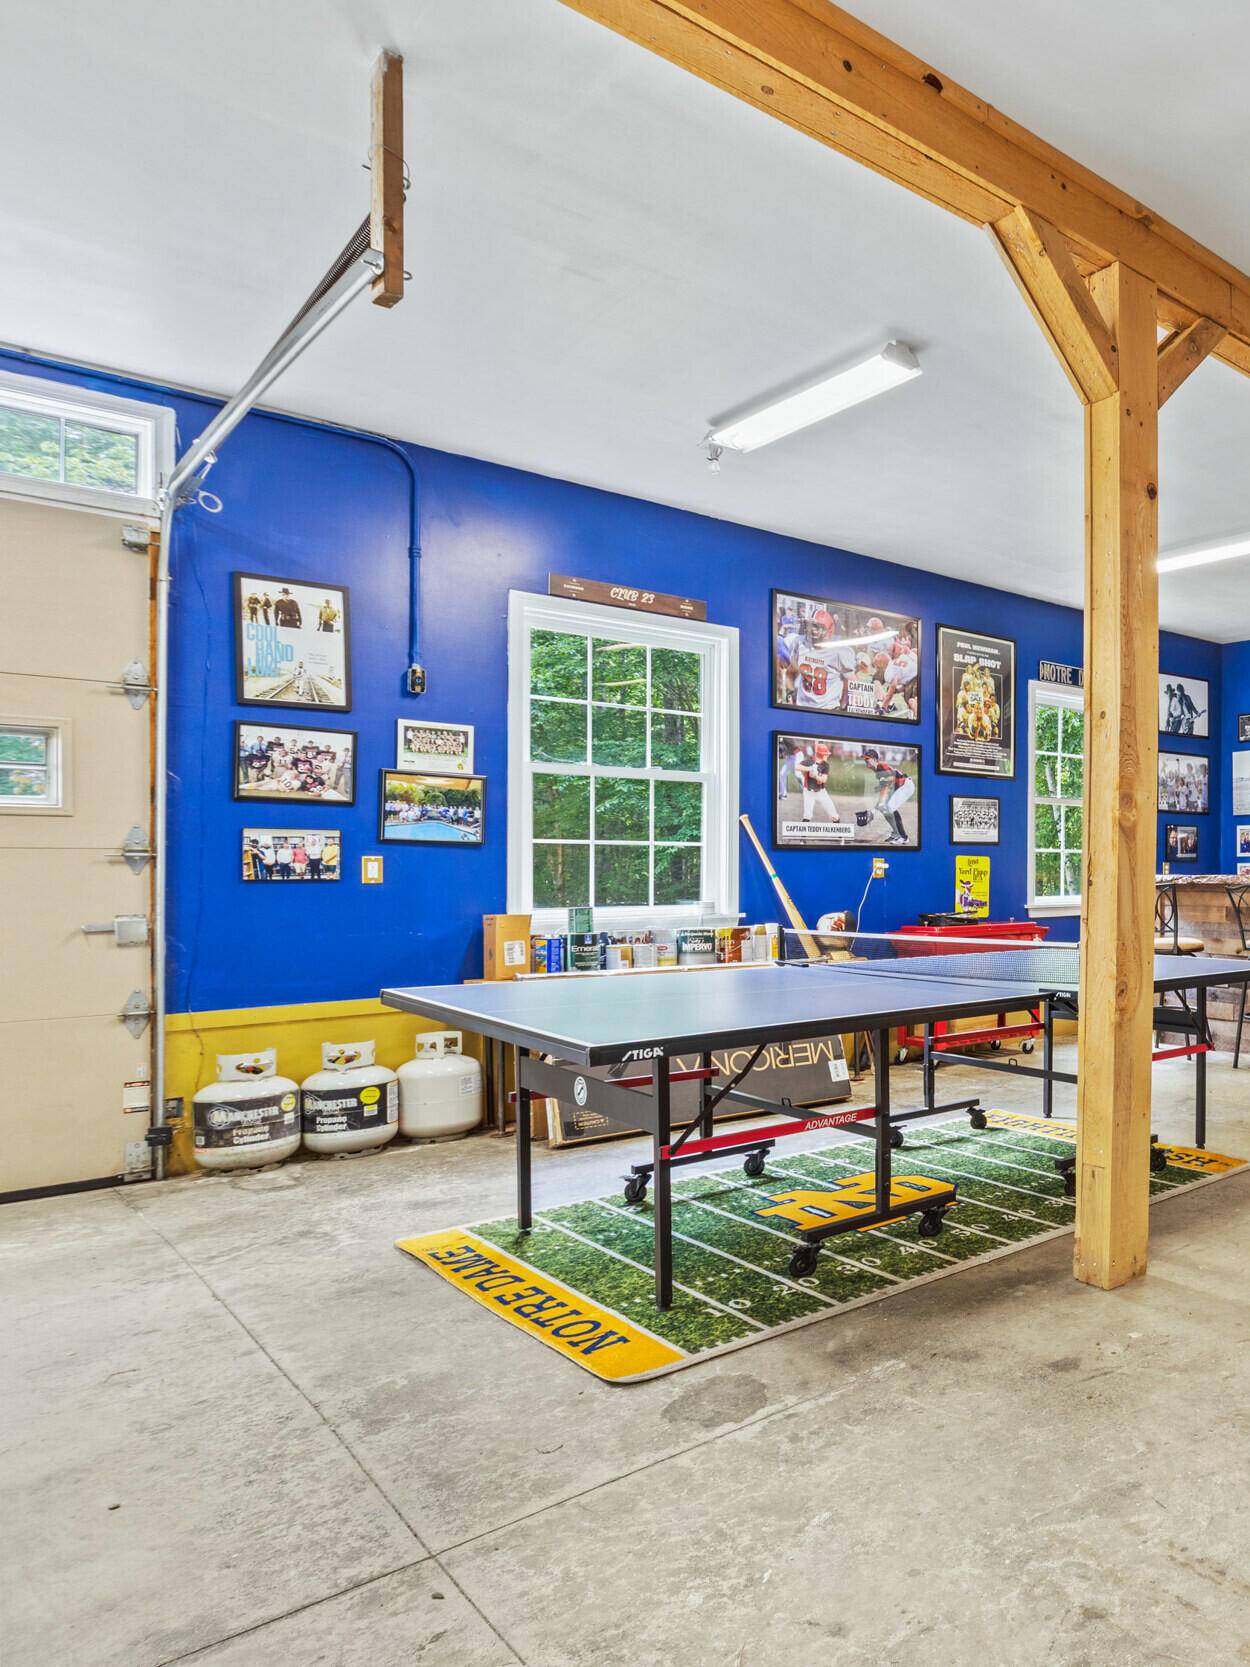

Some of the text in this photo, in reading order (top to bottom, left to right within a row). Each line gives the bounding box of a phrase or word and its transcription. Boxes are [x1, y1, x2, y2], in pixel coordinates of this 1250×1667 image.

[610, 587, 656, 605] CLUB 23
[247, 622, 277, 641] COOL
[256, 639, 294, 662] HAND
[953, 653, 977, 664] SLAP
[978, 657, 1002, 670] SHOT
[1043, 663, 1073, 685] NOTRE
[849, 681, 874, 693] CAPTAIN
[848, 693, 875, 708] TEDDY
[682, 942, 713, 951] IMPERVO
[622, 1046, 664, 1061] STIGA
[316, 1116, 347, 1125] Propane
[316, 1124, 348, 1132] Cylinder
[804, 1112, 858, 1130] ADVANTAGE
[232, 1125, 270, 1137] Propane
[233, 1133, 270, 1144] Cylinder
[836, 1257, 882, 1275] 30
[773, 1276, 820, 1296] 20
[428, 1245, 631, 1355] NOTRE DAME
[703, 1298, 751, 1318] 10
